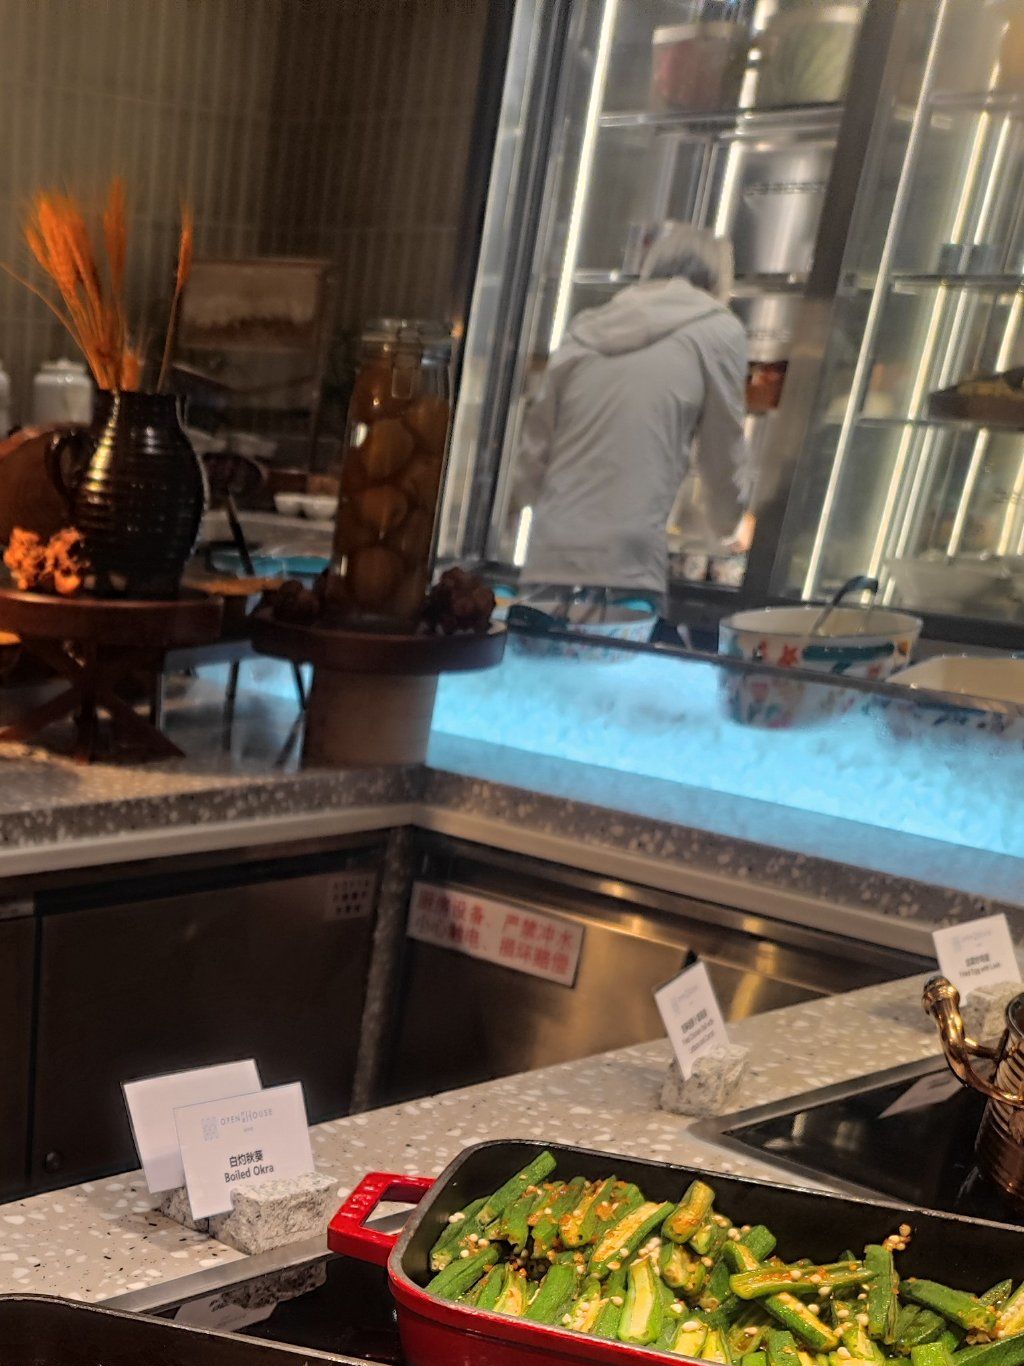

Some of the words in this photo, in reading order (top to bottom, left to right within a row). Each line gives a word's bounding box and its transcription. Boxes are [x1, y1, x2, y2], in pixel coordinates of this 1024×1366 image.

[229, 1150, 264, 1168] 白灼秋葵
[224, 1167, 251, 1183] Boiled
[253, 1164, 274, 1176] Okra
